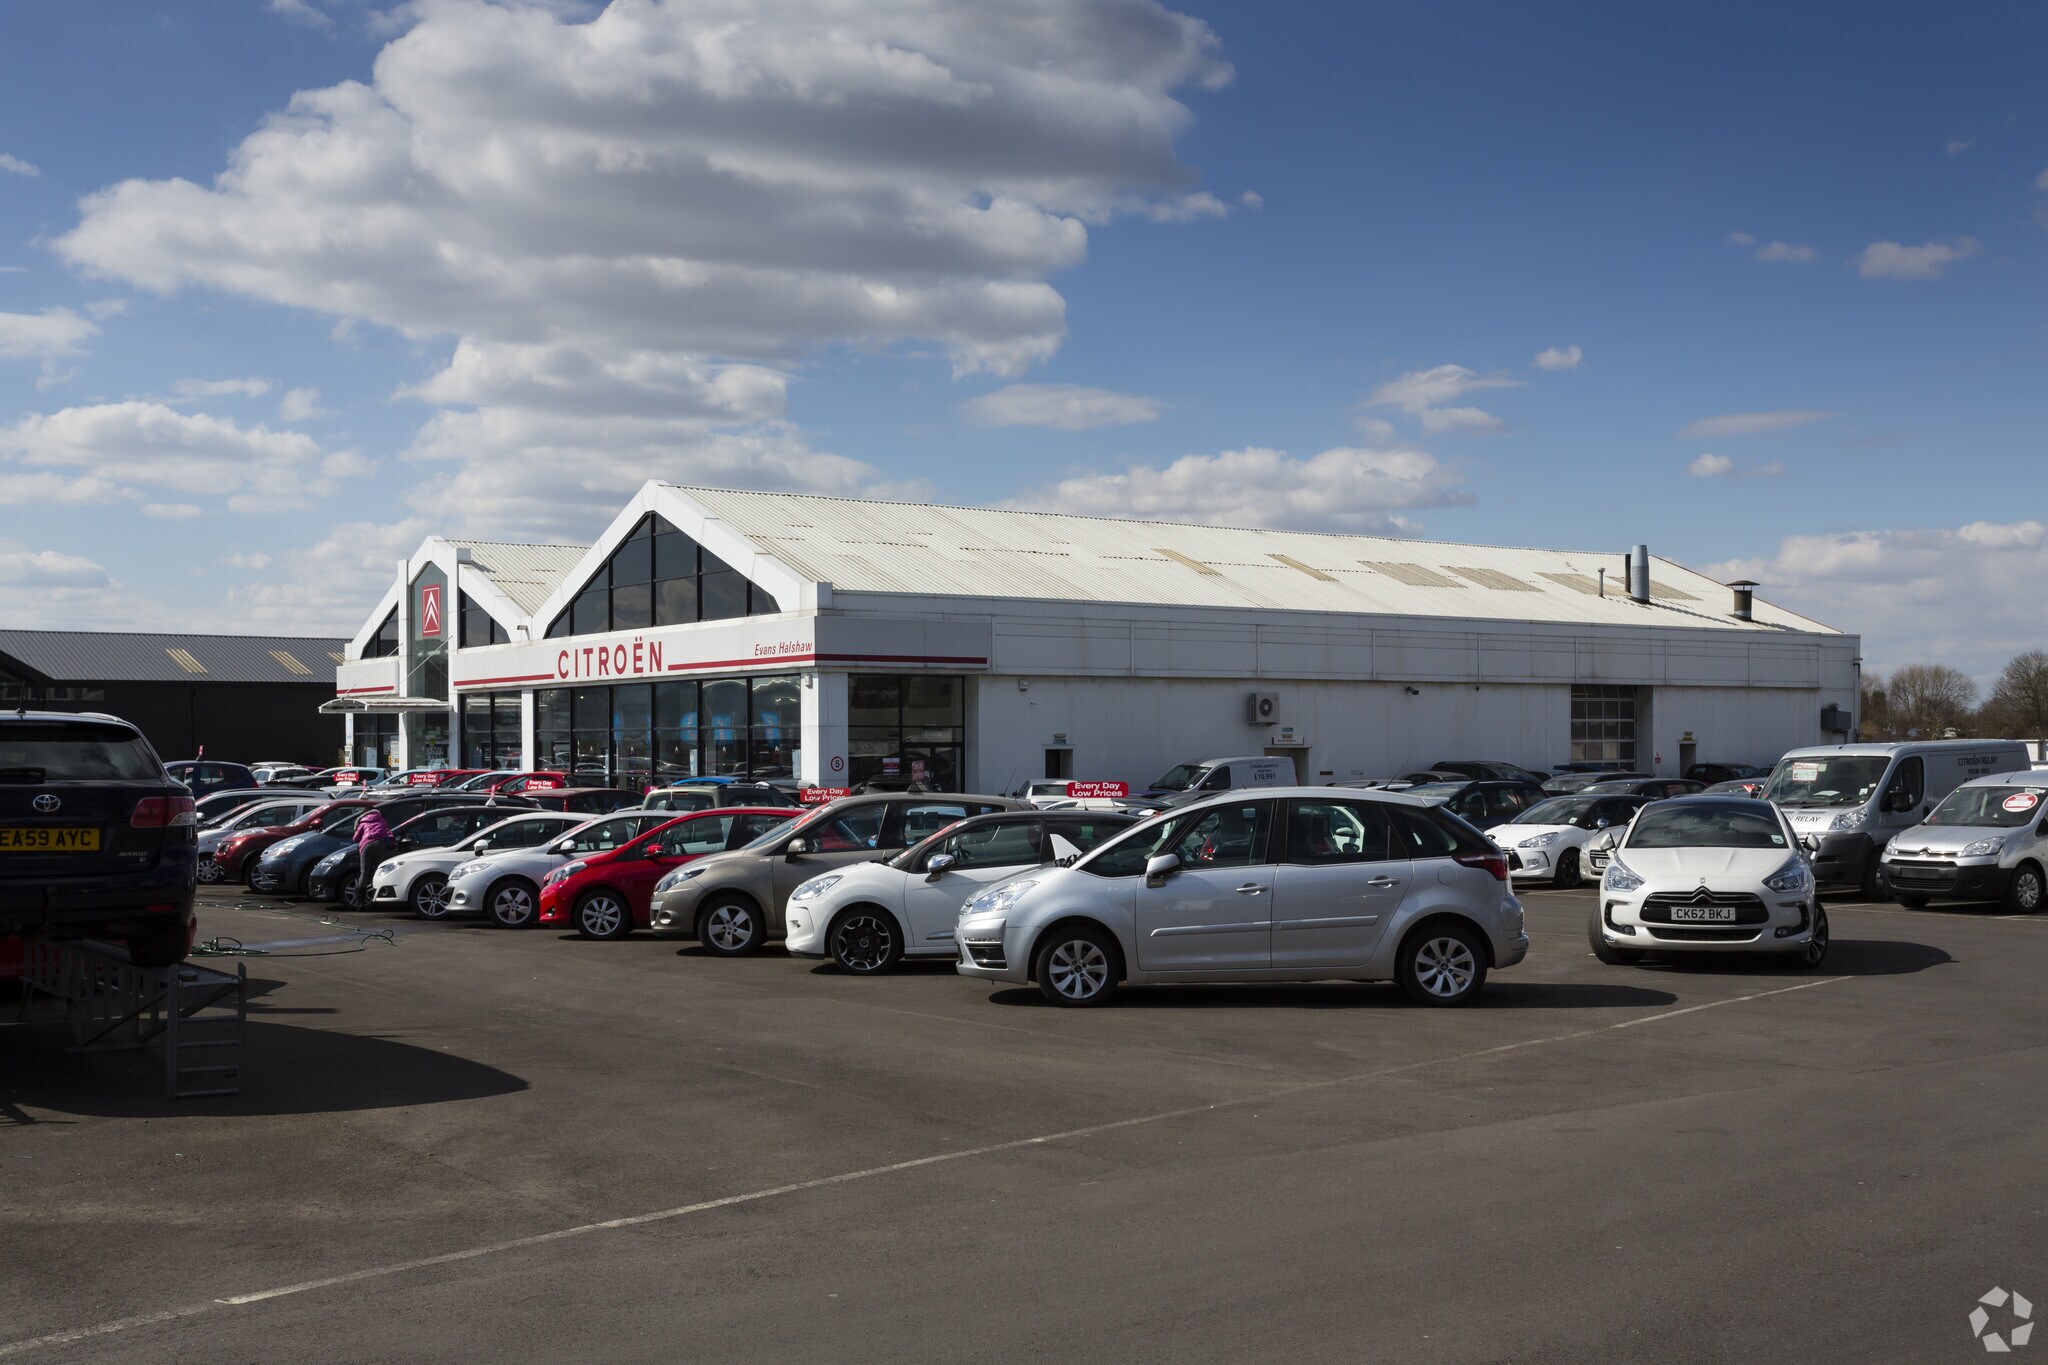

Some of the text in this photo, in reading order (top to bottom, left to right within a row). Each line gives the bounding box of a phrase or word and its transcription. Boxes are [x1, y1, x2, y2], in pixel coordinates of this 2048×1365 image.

[754, 641, 813, 656] Evans Halshaw
[557, 636, 662, 679] CITROËN
[1981, 756, 1997, 765] RELAY
[1074, 782, 1120, 791] Every Day
[807, 788, 828, 796] Every
[1093, 789, 1123, 797] Prices
[0, 830, 92, 846] EA59 AYC
[1676, 908, 1731, 919] CK62 BKJ
